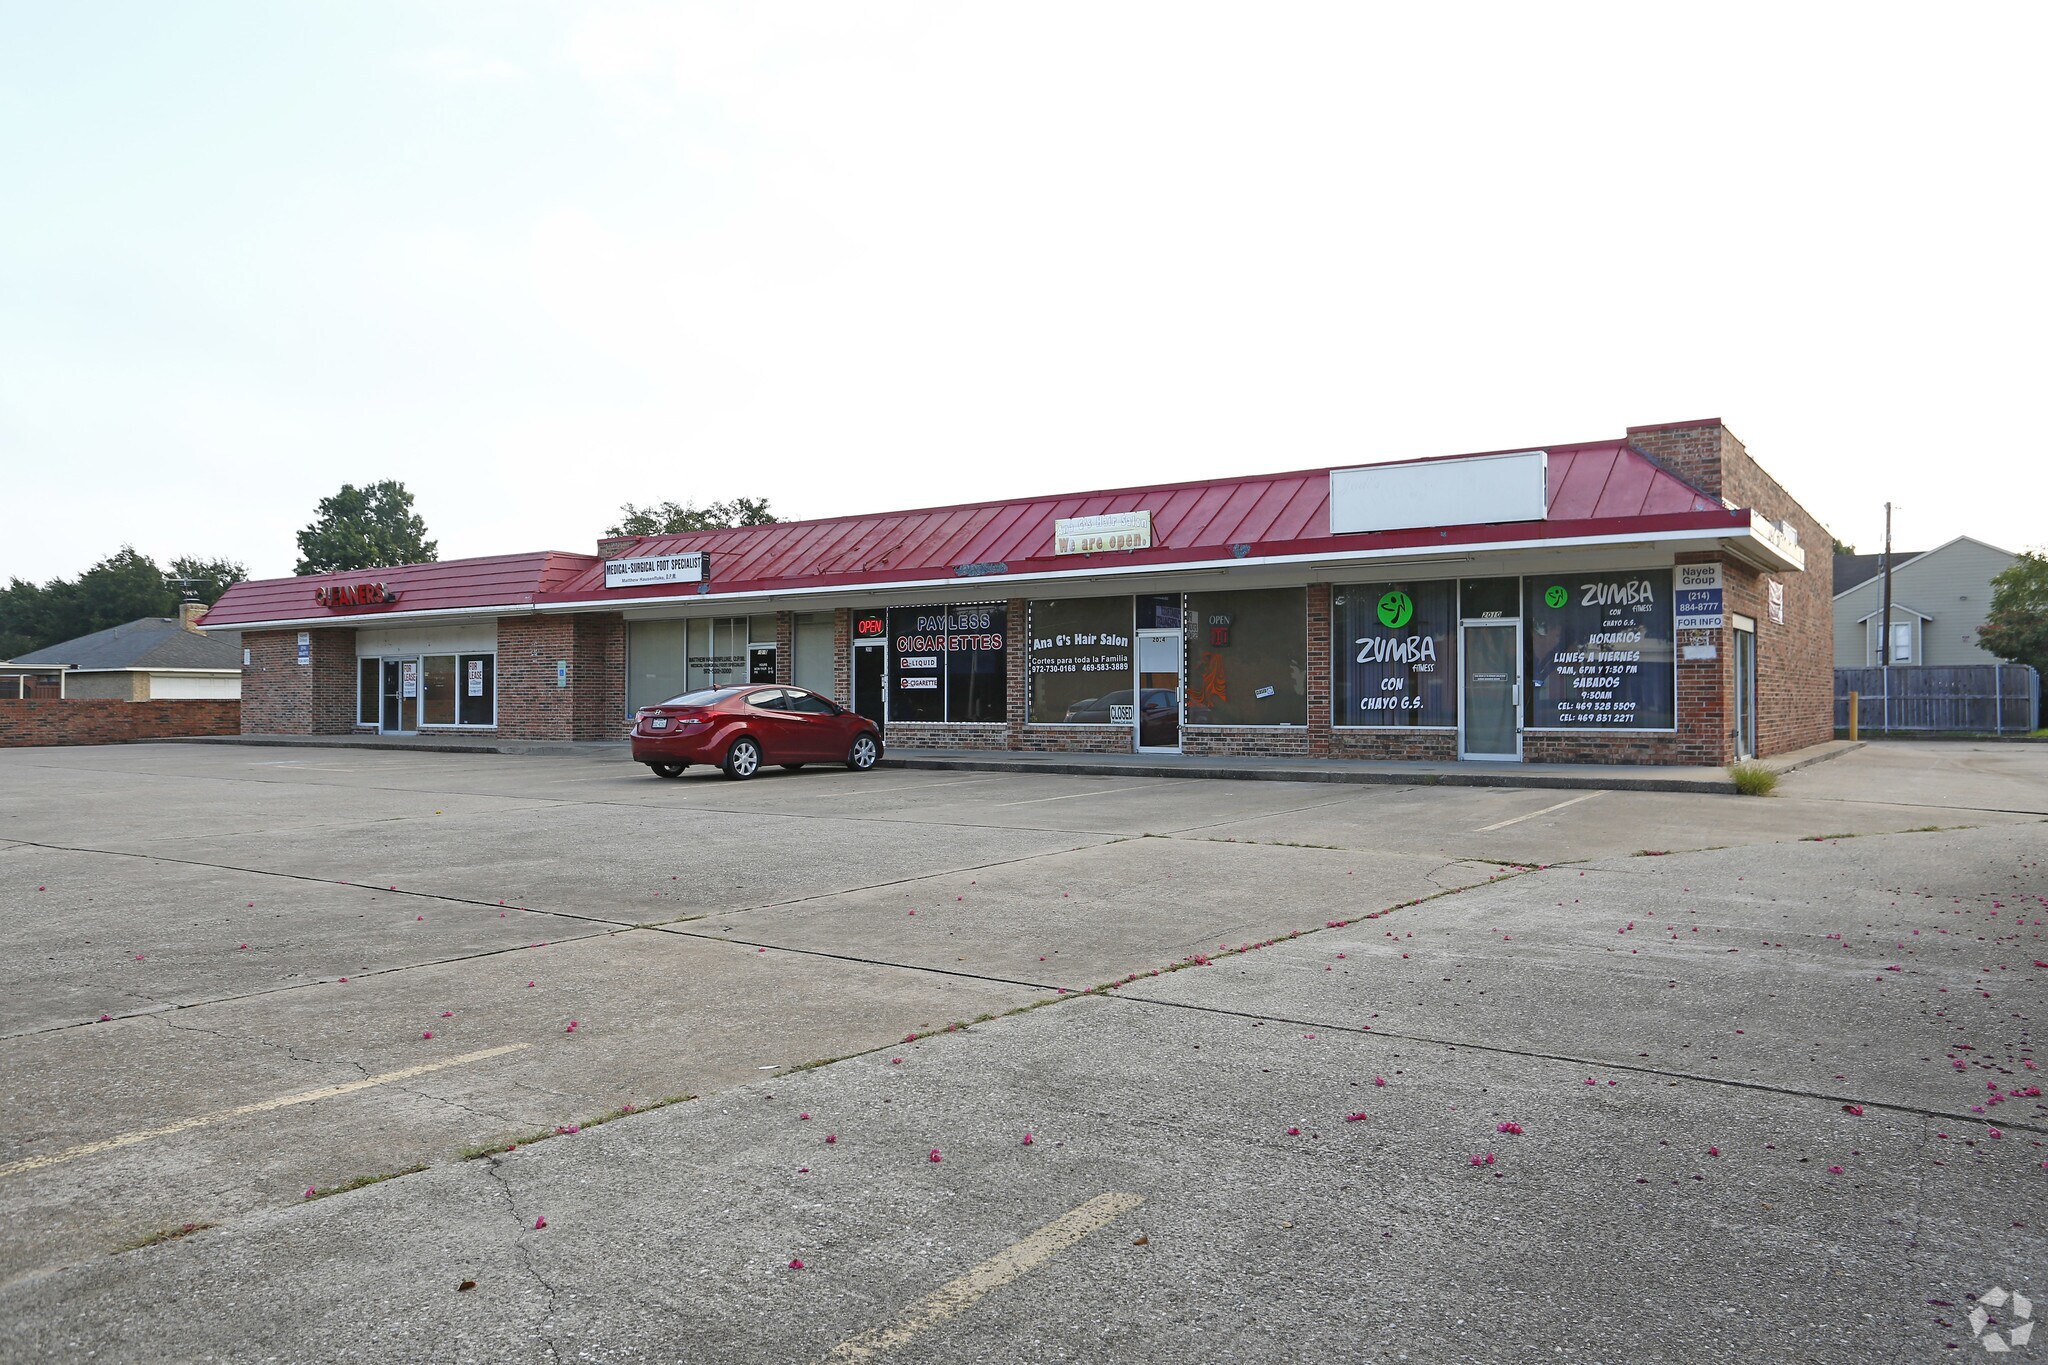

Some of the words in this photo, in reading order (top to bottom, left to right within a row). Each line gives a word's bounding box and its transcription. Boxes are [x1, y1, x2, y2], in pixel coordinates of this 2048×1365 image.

[1057, 524, 1074, 536] Ana
[1078, 519, 1092, 530] G's
[1096, 515, 1117, 527] Hair
[1121, 515, 1147, 528] Salon
[1058, 537, 1075, 552] We
[1081, 537, 1103, 550] are
[1109, 533, 1147, 550] open.
[606, 560, 655, 575] MEDICAL-SURGICAL
[656, 559, 670, 572] FOOT
[671, 557, 701, 570] SPECIALIST
[1682, 566, 1715, 577] Nayeb
[1682, 576, 1715, 585] Group
[315, 582, 385, 606] CLEANERS
[1580, 580, 1654, 606] ZUMBA
[1688, 591, 1710, 601] (214)
[1609, 608, 1622, 616] CON
[1680, 602, 1719, 612] 884-8777
[917, 613, 990, 631] PAYLESS
[1208, 615, 1231, 624] OPEN
[1603, 619, 1622, 627] CHAYO
[1678, 618, 1697, 627] FOR
[1699, 617, 1721, 626] INFO
[858, 619, 882, 633] OPEN
[896, 633, 1002, 652] CIGARETTES
[1033, 638, 1053, 650] Ana
[1055, 634, 1071, 646] G's
[1074, 633, 1097, 645] Hair
[1100, 633, 1128, 647] Salon
[1589, 631, 1641, 644] HORARIOS
[1355, 635, 1436, 664] ZUMBA
[1031, 657, 1055, 665] Cortes
[1074, 656, 1090, 664] toda
[1092, 655, 1099, 663] la
[1101, 655, 1128, 663] Familia
[1554, 652, 1585, 663] LUNES
[1587, 652, 1595, 663] A
[1598, 651, 1640, 662] VIERNES
[469, 662, 477, 670] FOR
[901, 658, 935, 668] e-LIQUID
[1031, 664, 1076, 673] 972-730-0168
[1082, 663, 1128, 672] 469-583-3889
[1556, 666, 1576, 675] 9AM,
[1579, 666, 1596, 674] 6PM
[1598, 666, 1603, 674] Y
[1605, 665, 1624, 674] 7:30
[1625, 665, 1638, 674] PM
[404, 673, 416, 681] LEASE
[469, 671, 482, 680] LEASE
[1380, 677, 1404, 691] CON
[1573, 676, 1620, 688] SABADOS
[1581, 691, 1613, 700] 9:30AM
[1360, 696, 1398, 710] CHAYO
[1400, 696, 1424, 709] G.S.
[1557, 702, 1574, 710] CEL:
[1575, 702, 1592, 710] 469
[1594, 702, 1611, 710] 328
[1613, 702, 1636, 710] 5509
[1110, 706, 1133, 720] CLOSED
[1595, 714, 1612, 722] 831
[1613, 714, 1634, 722] 2271
